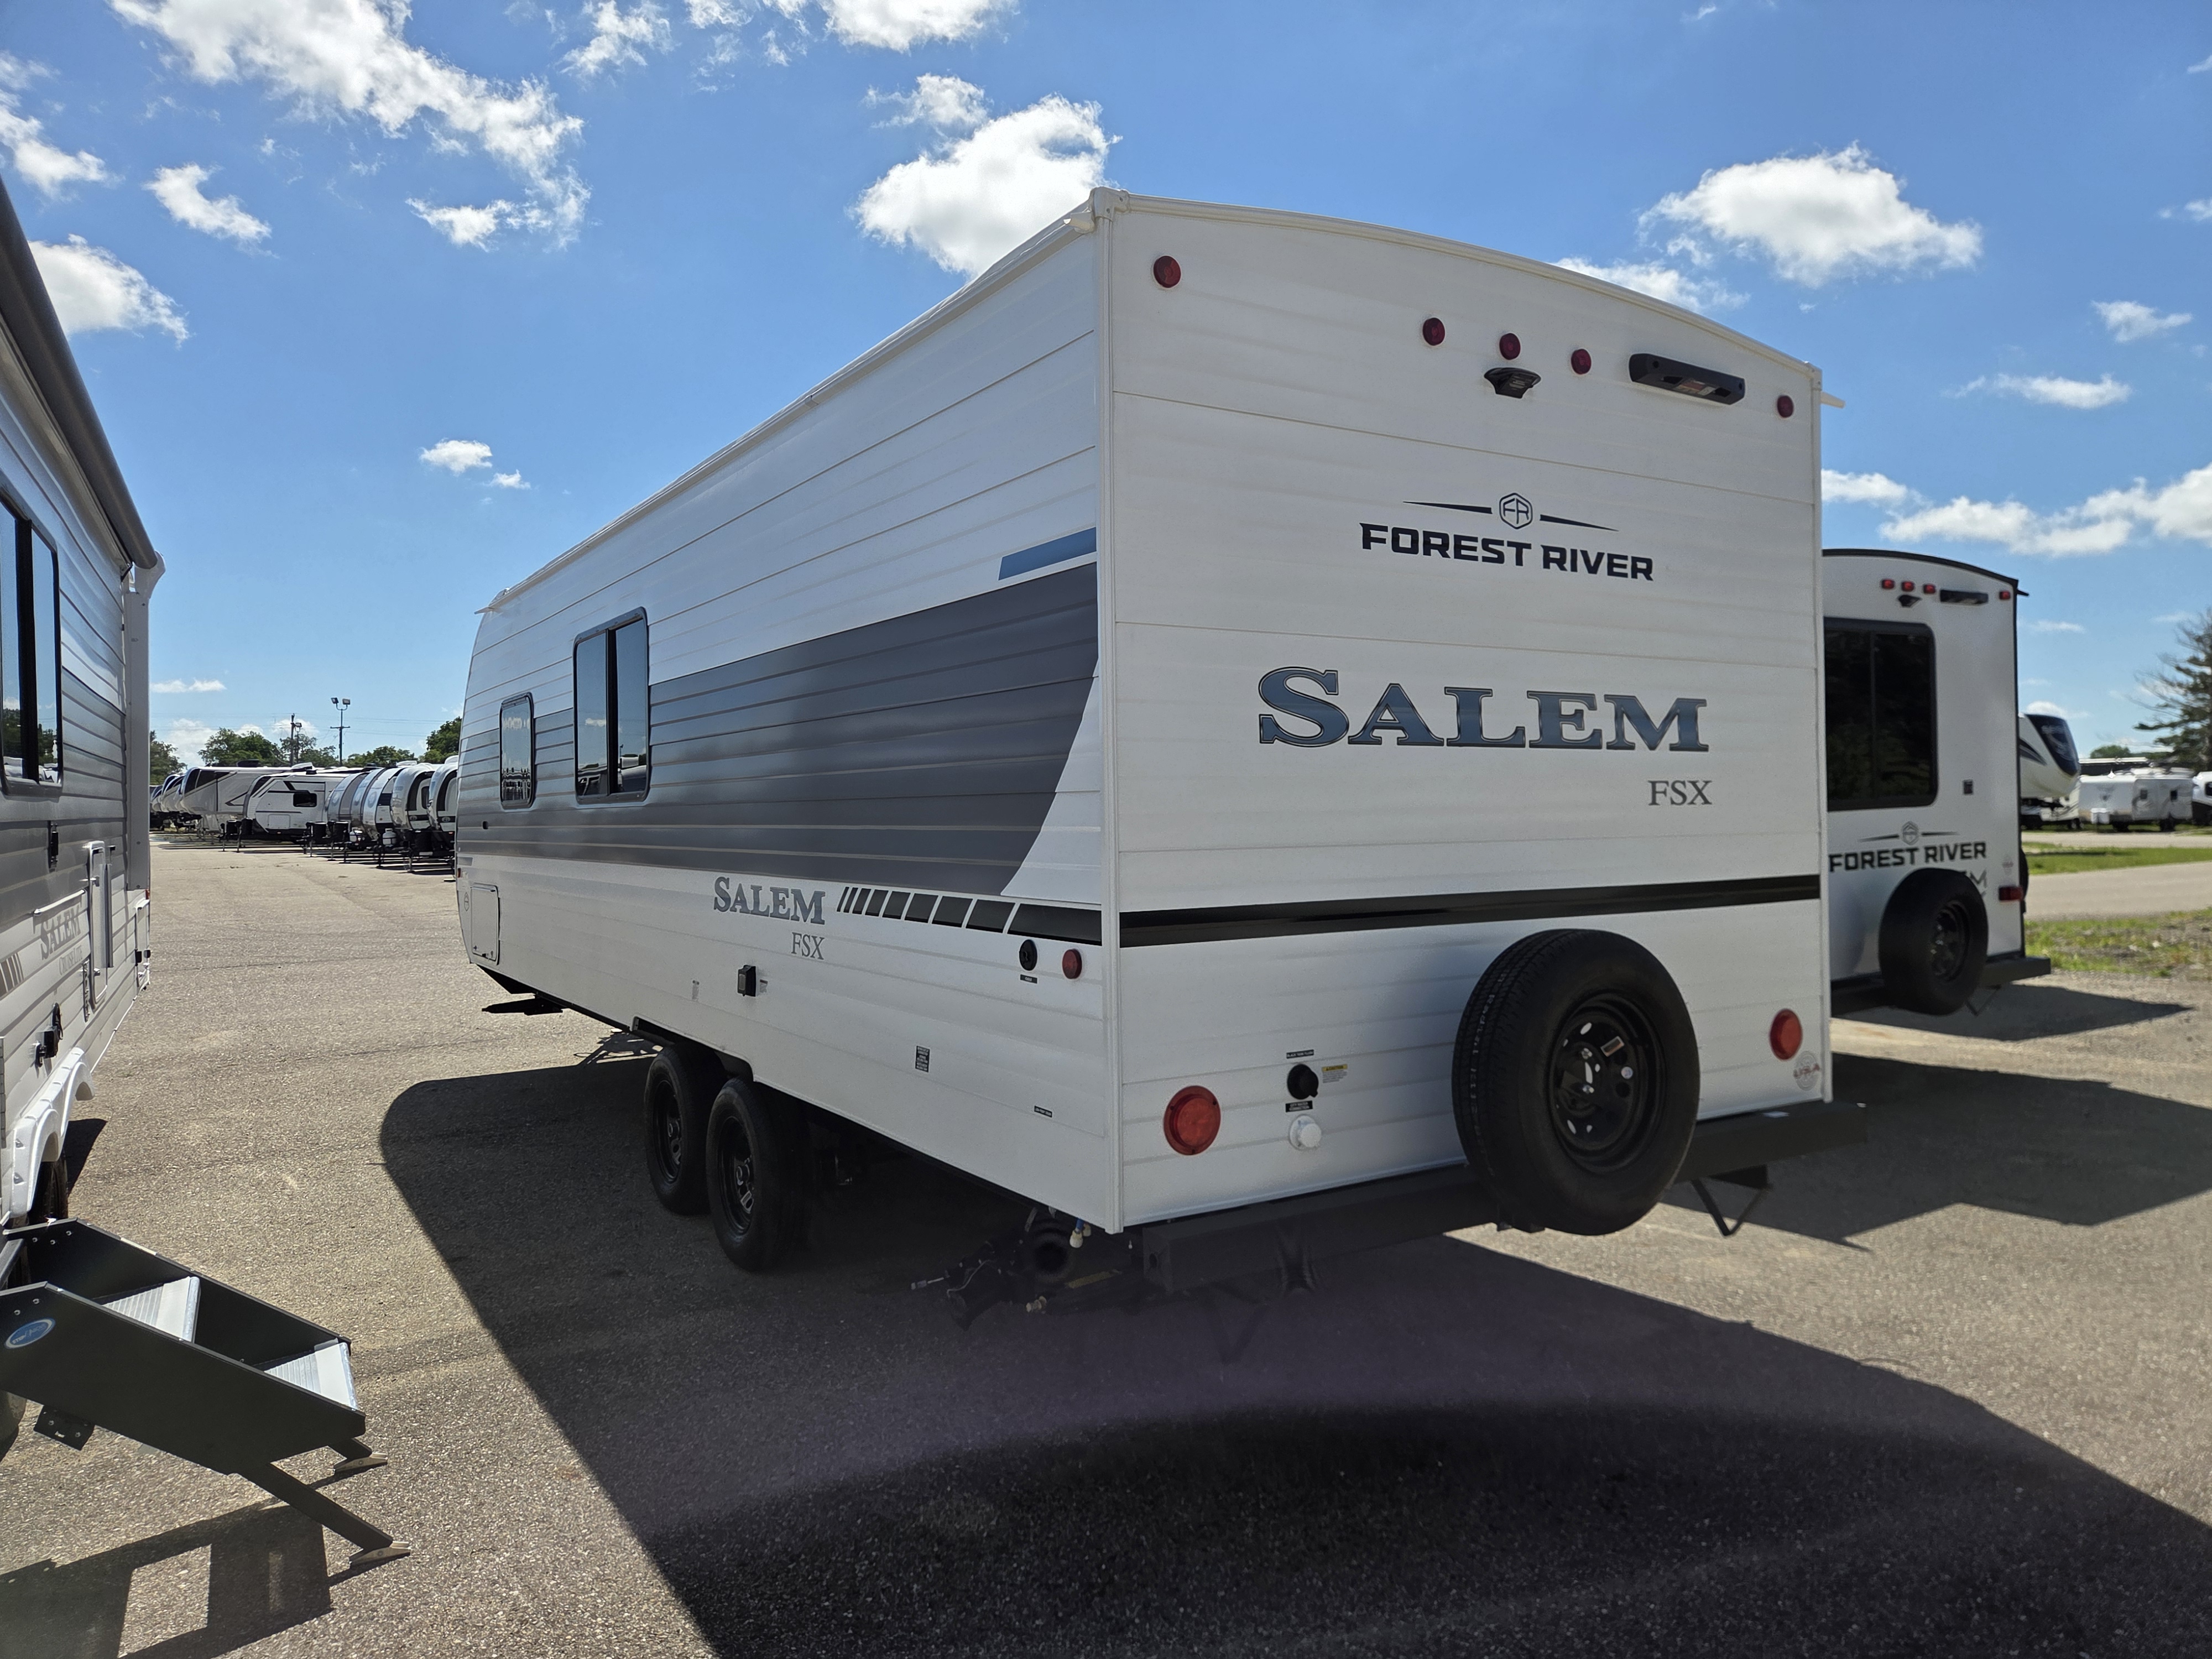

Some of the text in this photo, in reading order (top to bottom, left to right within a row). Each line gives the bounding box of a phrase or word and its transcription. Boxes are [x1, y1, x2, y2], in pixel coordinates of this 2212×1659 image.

[1359, 523, 1653, 581] FOREST RIVER
[1259, 666, 1709, 752] SALEM
[1648, 780, 1712, 806] FSX
[1828, 842, 1986, 872] FOREST RIVER
[714, 877, 826, 925] SALEM
[40, 905, 81, 960] SALEM
[791, 932, 825, 960] FSX
